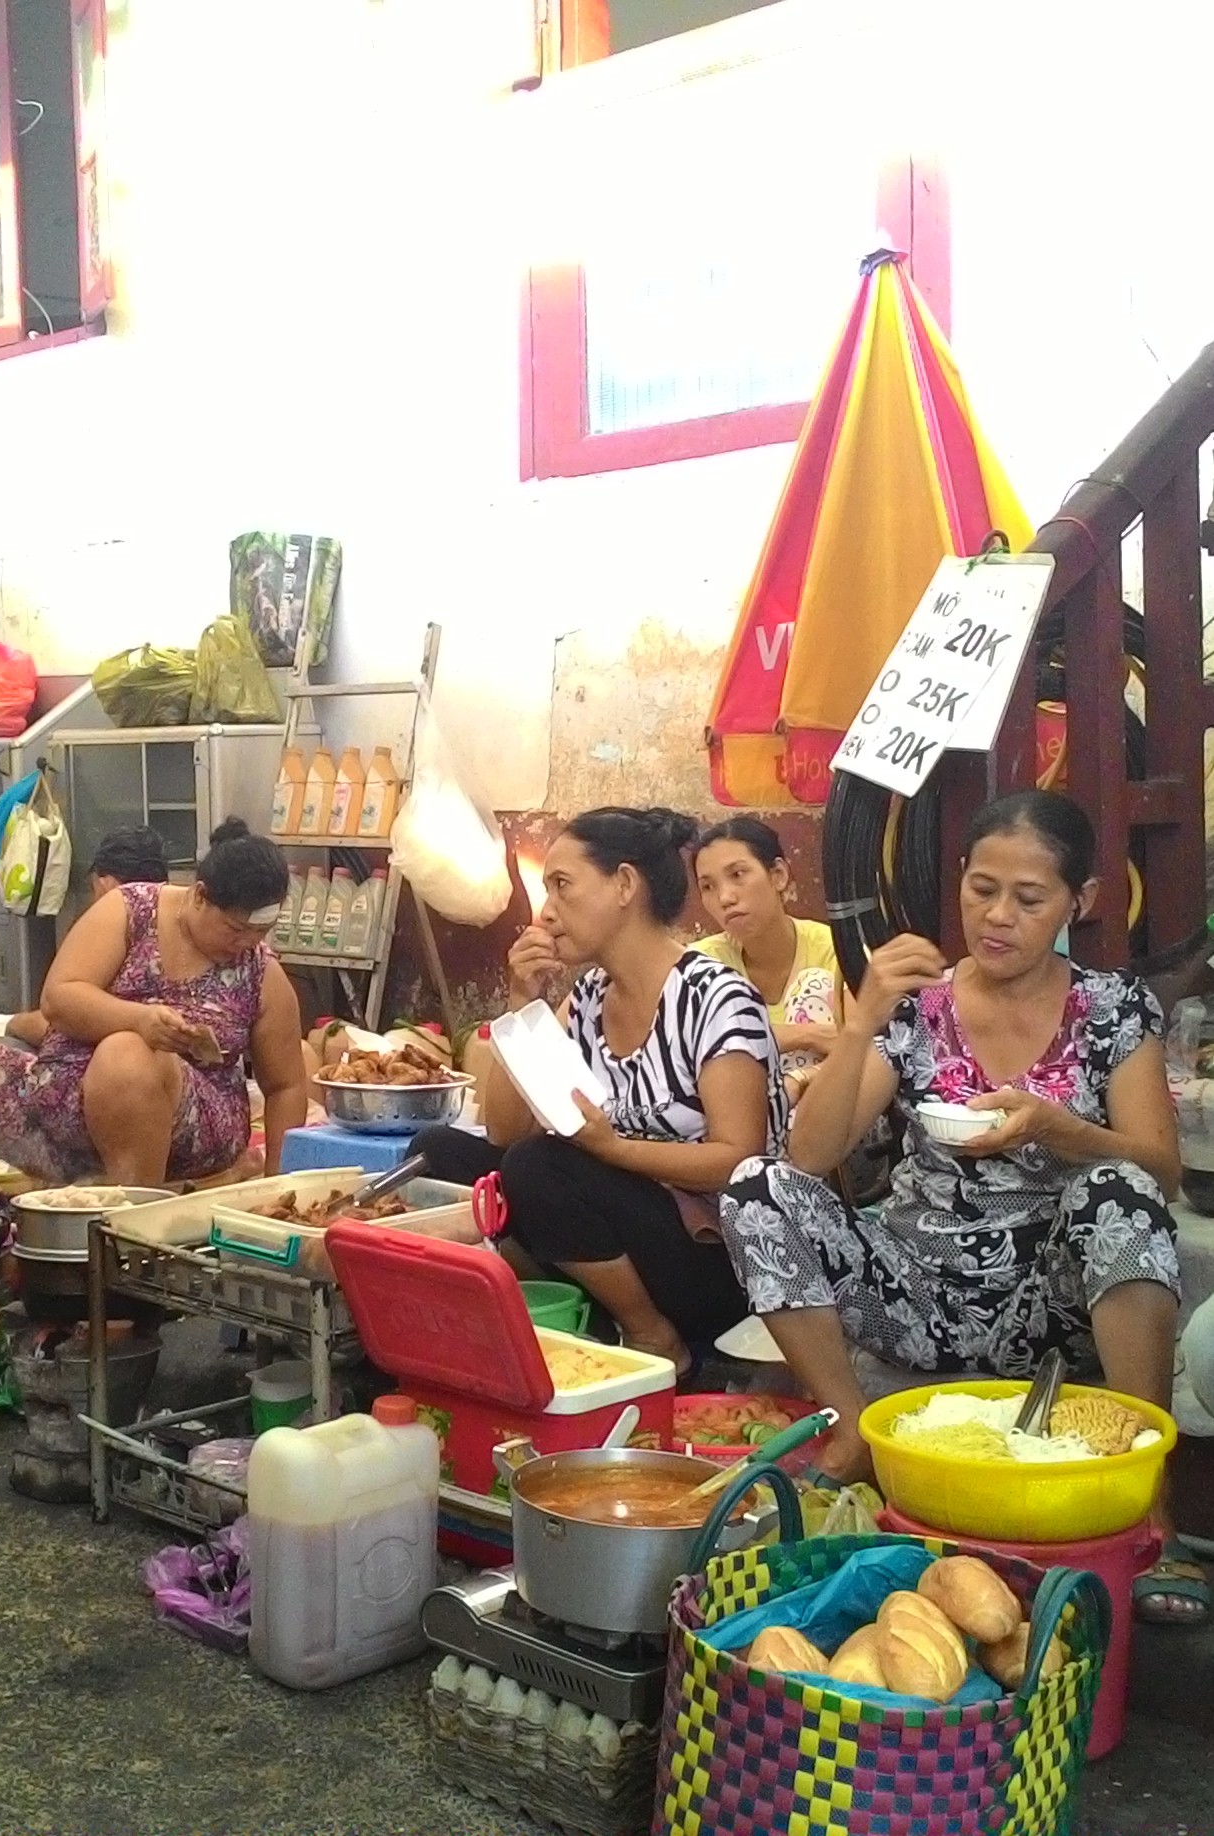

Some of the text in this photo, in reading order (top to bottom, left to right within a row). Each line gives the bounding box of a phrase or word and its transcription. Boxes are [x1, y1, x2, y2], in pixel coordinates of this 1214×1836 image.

[943, 618, 1012, 668] 20K
[907, 677, 969, 723] 25K
[875, 726, 939, 776] 20K
